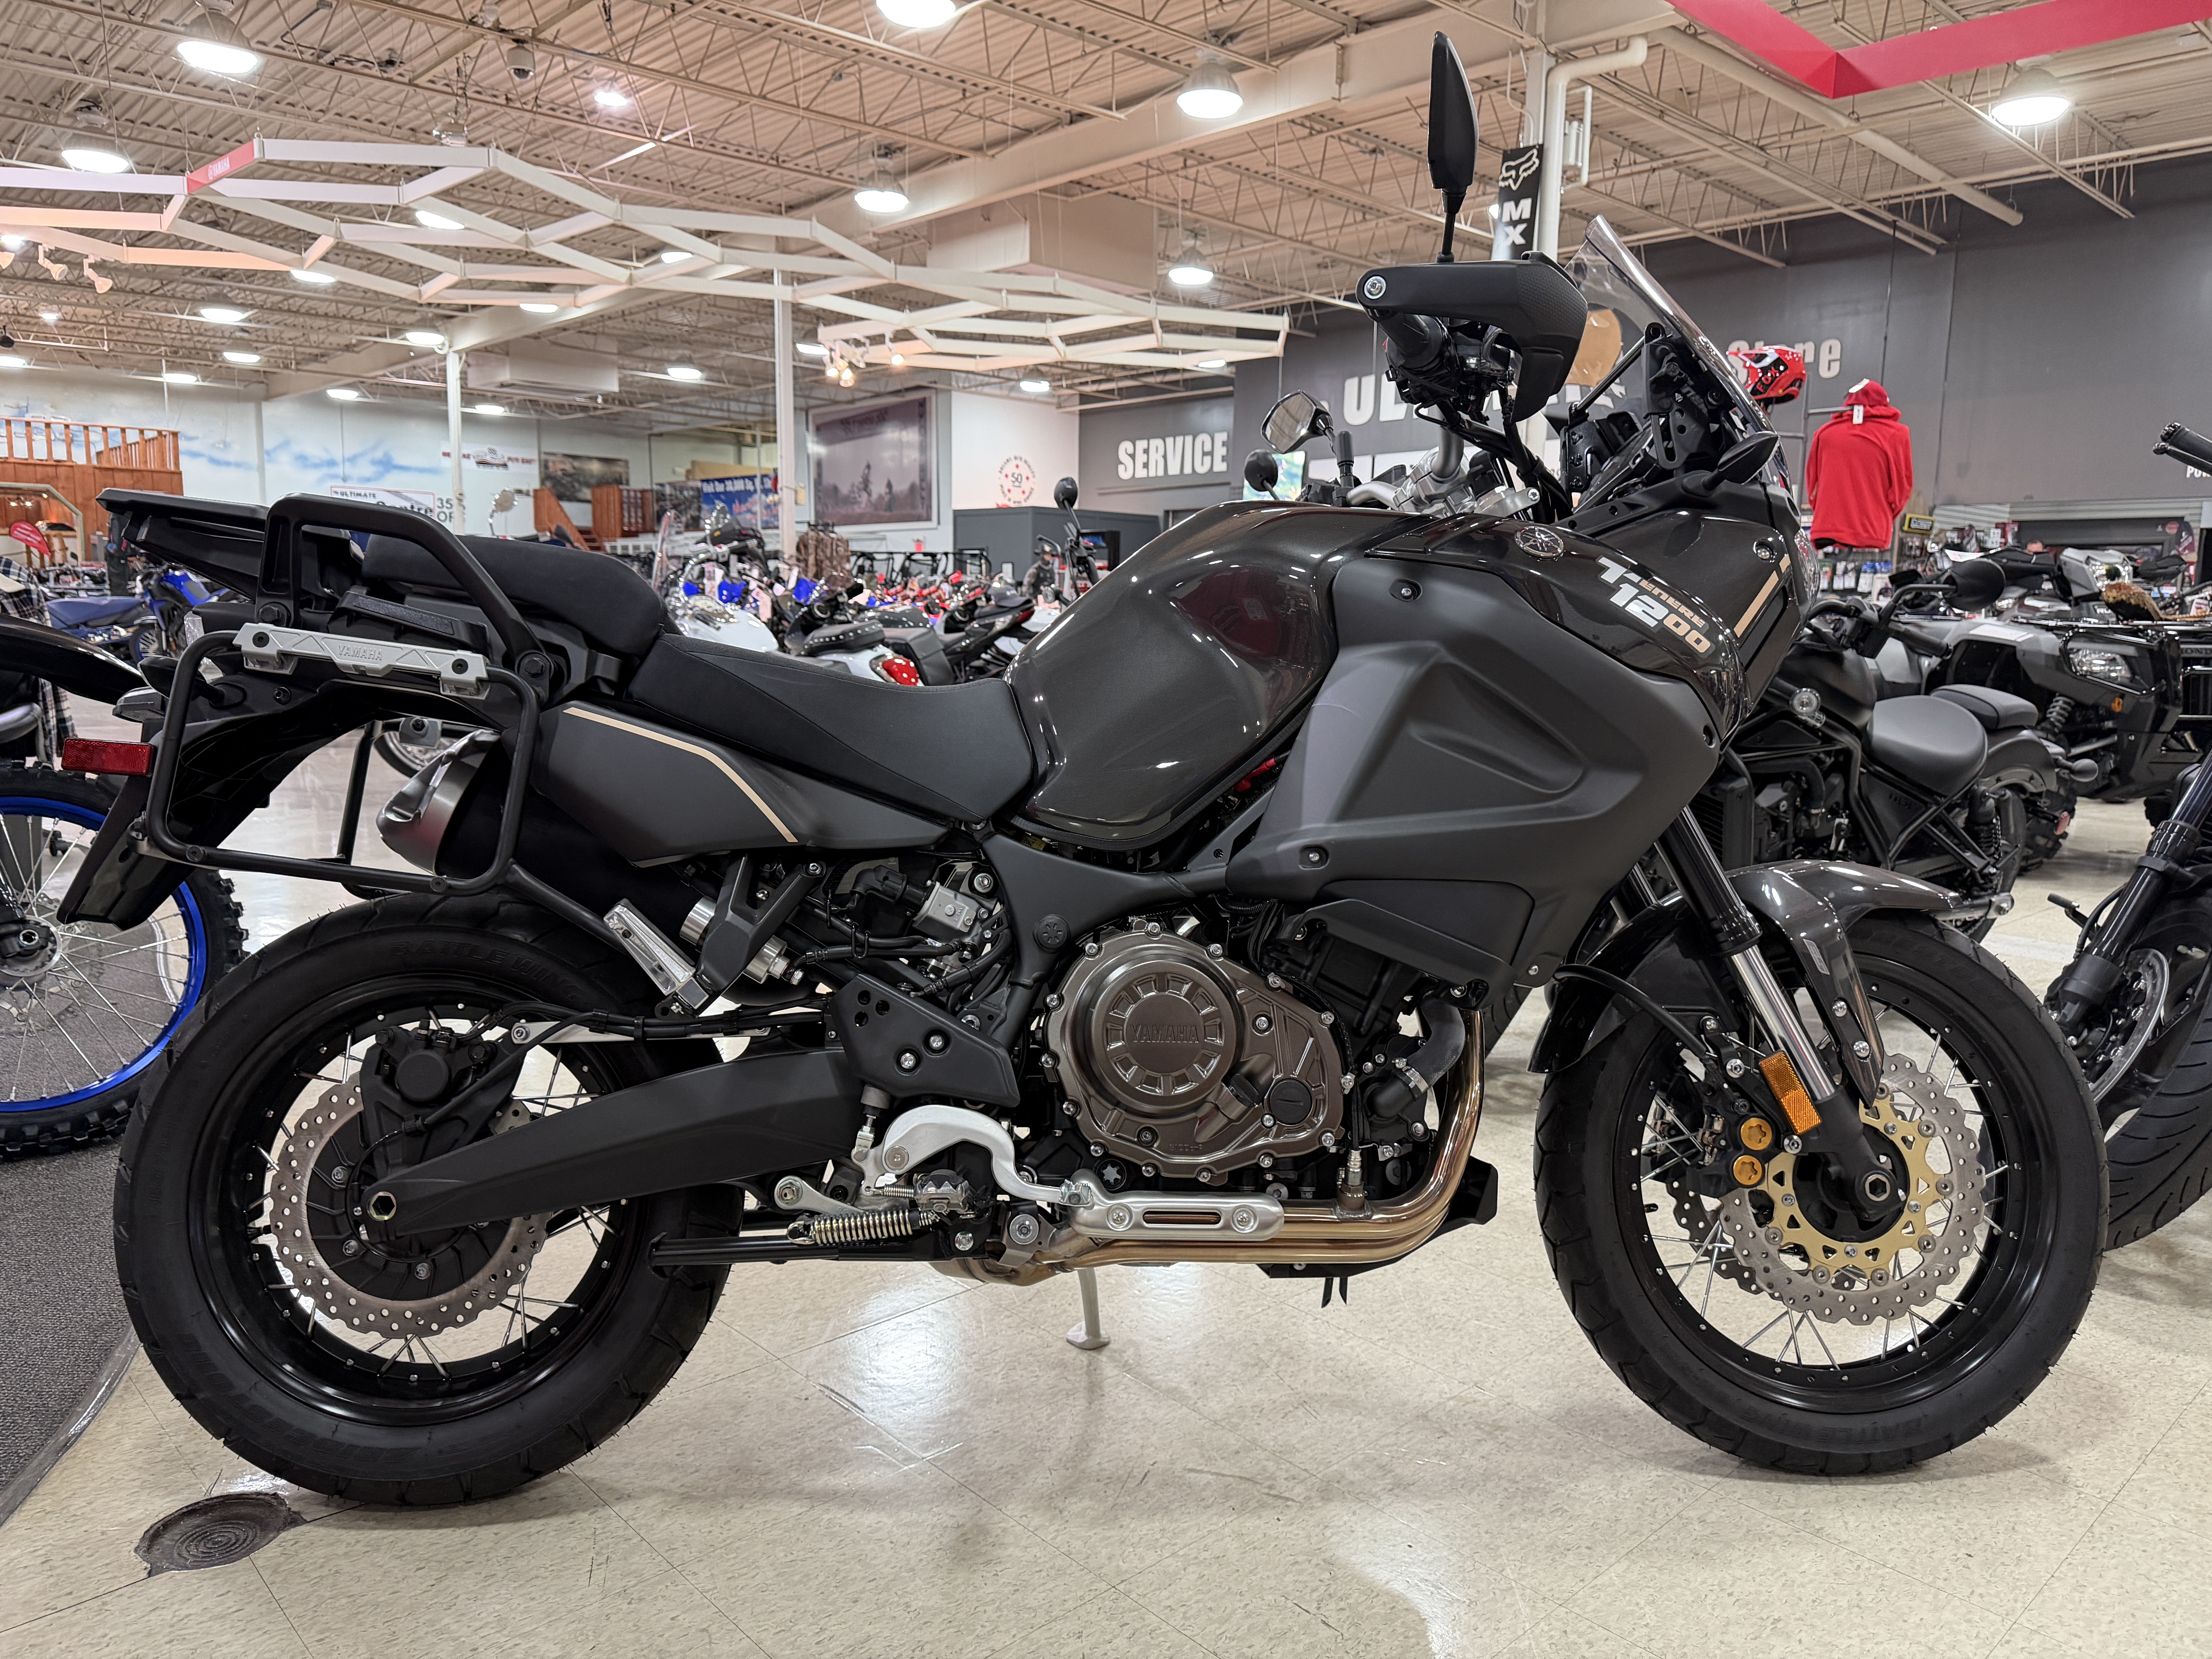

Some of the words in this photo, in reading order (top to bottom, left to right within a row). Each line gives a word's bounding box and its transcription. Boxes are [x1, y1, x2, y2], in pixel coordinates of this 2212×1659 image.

[212, 156, 230, 177] YAMAHA
[1757, 366, 1779, 392] FOX
[1118, 431, 1228, 480] SERVICE
[1011, 472, 1022, 484] 50
[340, 491, 376, 499] ULTIMATE
[1609, 583, 1711, 653] 1200
[338, 644, 383, 661] YAMAHA
[390, 939, 509, 965] BATTLE
[510, 954, 584, 1001] WING
[1130, 1024, 1200, 1044] YAMAHA
